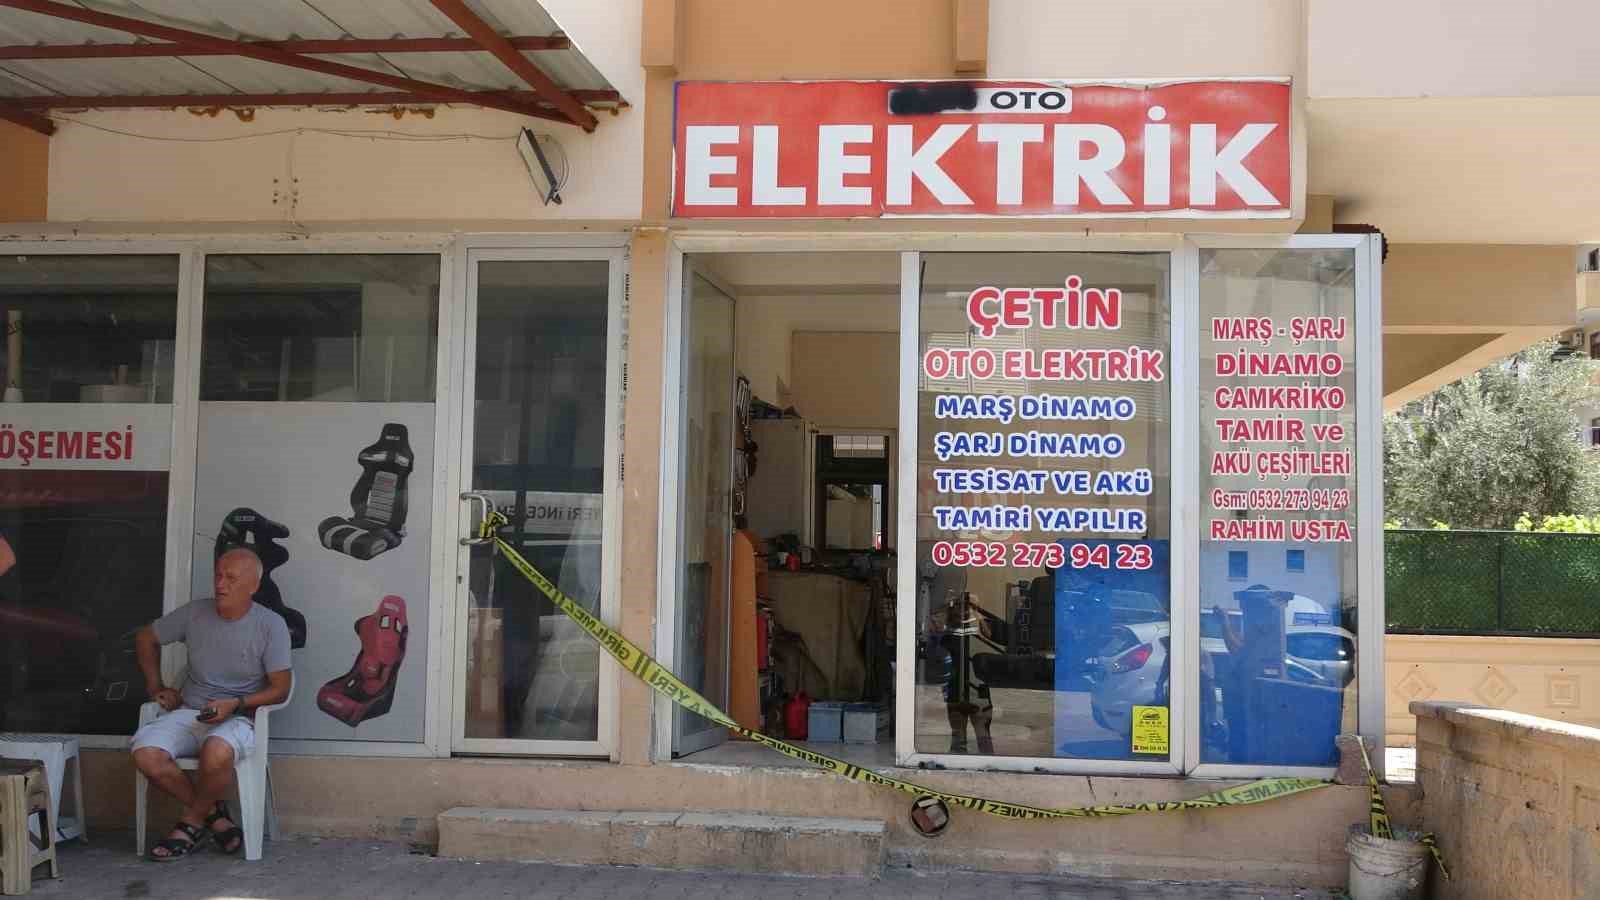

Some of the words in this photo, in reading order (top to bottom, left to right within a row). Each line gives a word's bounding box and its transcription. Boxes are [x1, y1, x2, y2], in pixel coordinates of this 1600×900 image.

[990, 91, 1066, 110] OTO
[684, 105, 1281, 207] ELEKTRİK
[968, 276, 1121, 336] ÇETİN
[1212, 317, 1272, 346] MARŞ
[1291, 317, 1345, 346] ŞARJ
[925, 350, 995, 379] OTO
[1216, 348, 1343, 375] DİNAMO
[936, 396, 1014, 422] MARŞ
[1215, 381, 1345, 410] CAMKRİKO
[1216, 413, 1304, 442] TAMİR
[1313, 424, 1344, 442] ve
[935, 433, 1002, 459] ŞARJ
[1212, 448, 1251, 475] AKÜ
[1256, 447, 1351, 481] ÇEŞİTLERİ
[1054, 471, 1090, 494] VE
[1095, 469, 1153, 496] AKÜ
[1249, 489, 1281, 509] 0532
[1285, 490, 1310, 510] 273
[1313, 490, 1330, 510] 94
[1333, 490, 1349, 510] 23
[1036, 506, 1147, 533] YAPILIR
[1211, 514, 1284, 540] RAHİM
[1291, 520, 1351, 541] USTA
[932, 542, 1006, 568] 0532
[1012, 542, 1064, 569] 273
[1071, 544, 1109, 569] 94
[1116, 544, 1153, 569] 23
